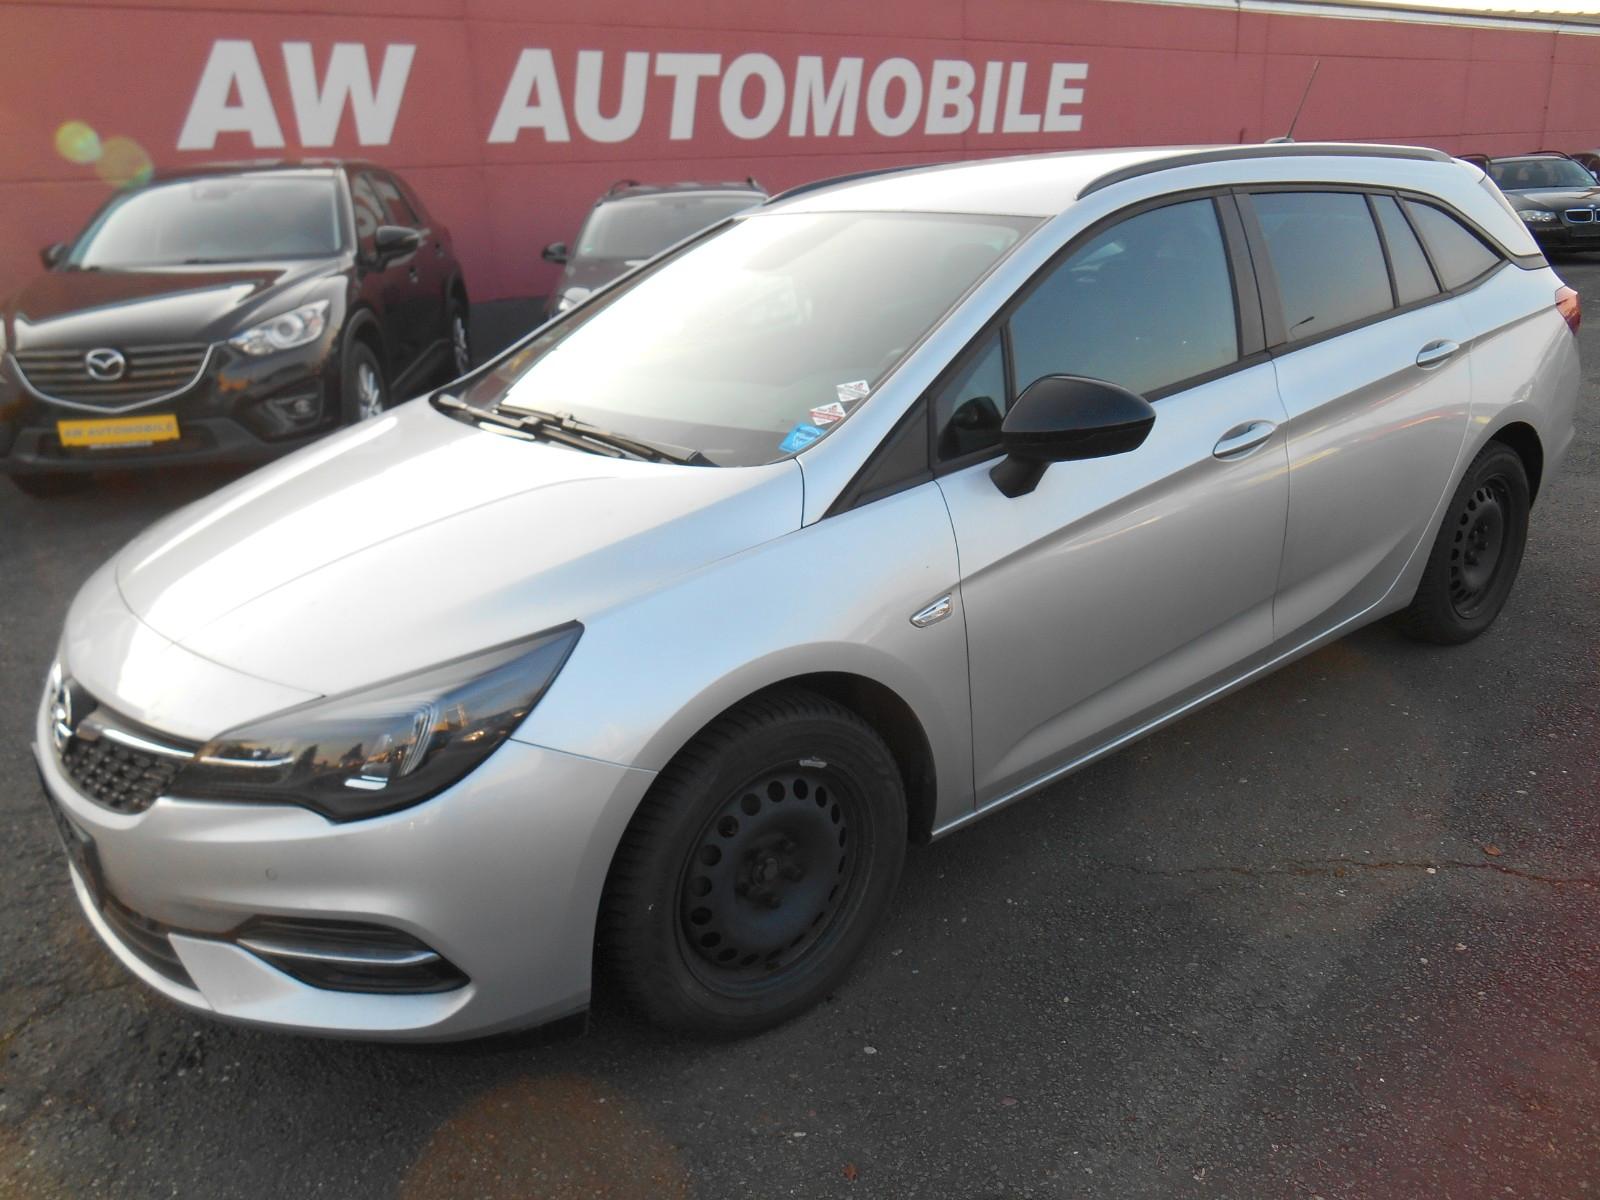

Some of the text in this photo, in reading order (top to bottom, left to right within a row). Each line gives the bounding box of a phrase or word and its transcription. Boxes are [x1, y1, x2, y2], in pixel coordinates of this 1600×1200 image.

[176, 39, 1089, 151] AW AUTOMOBILE
[88, 422, 174, 437] AUTOMOBILE
